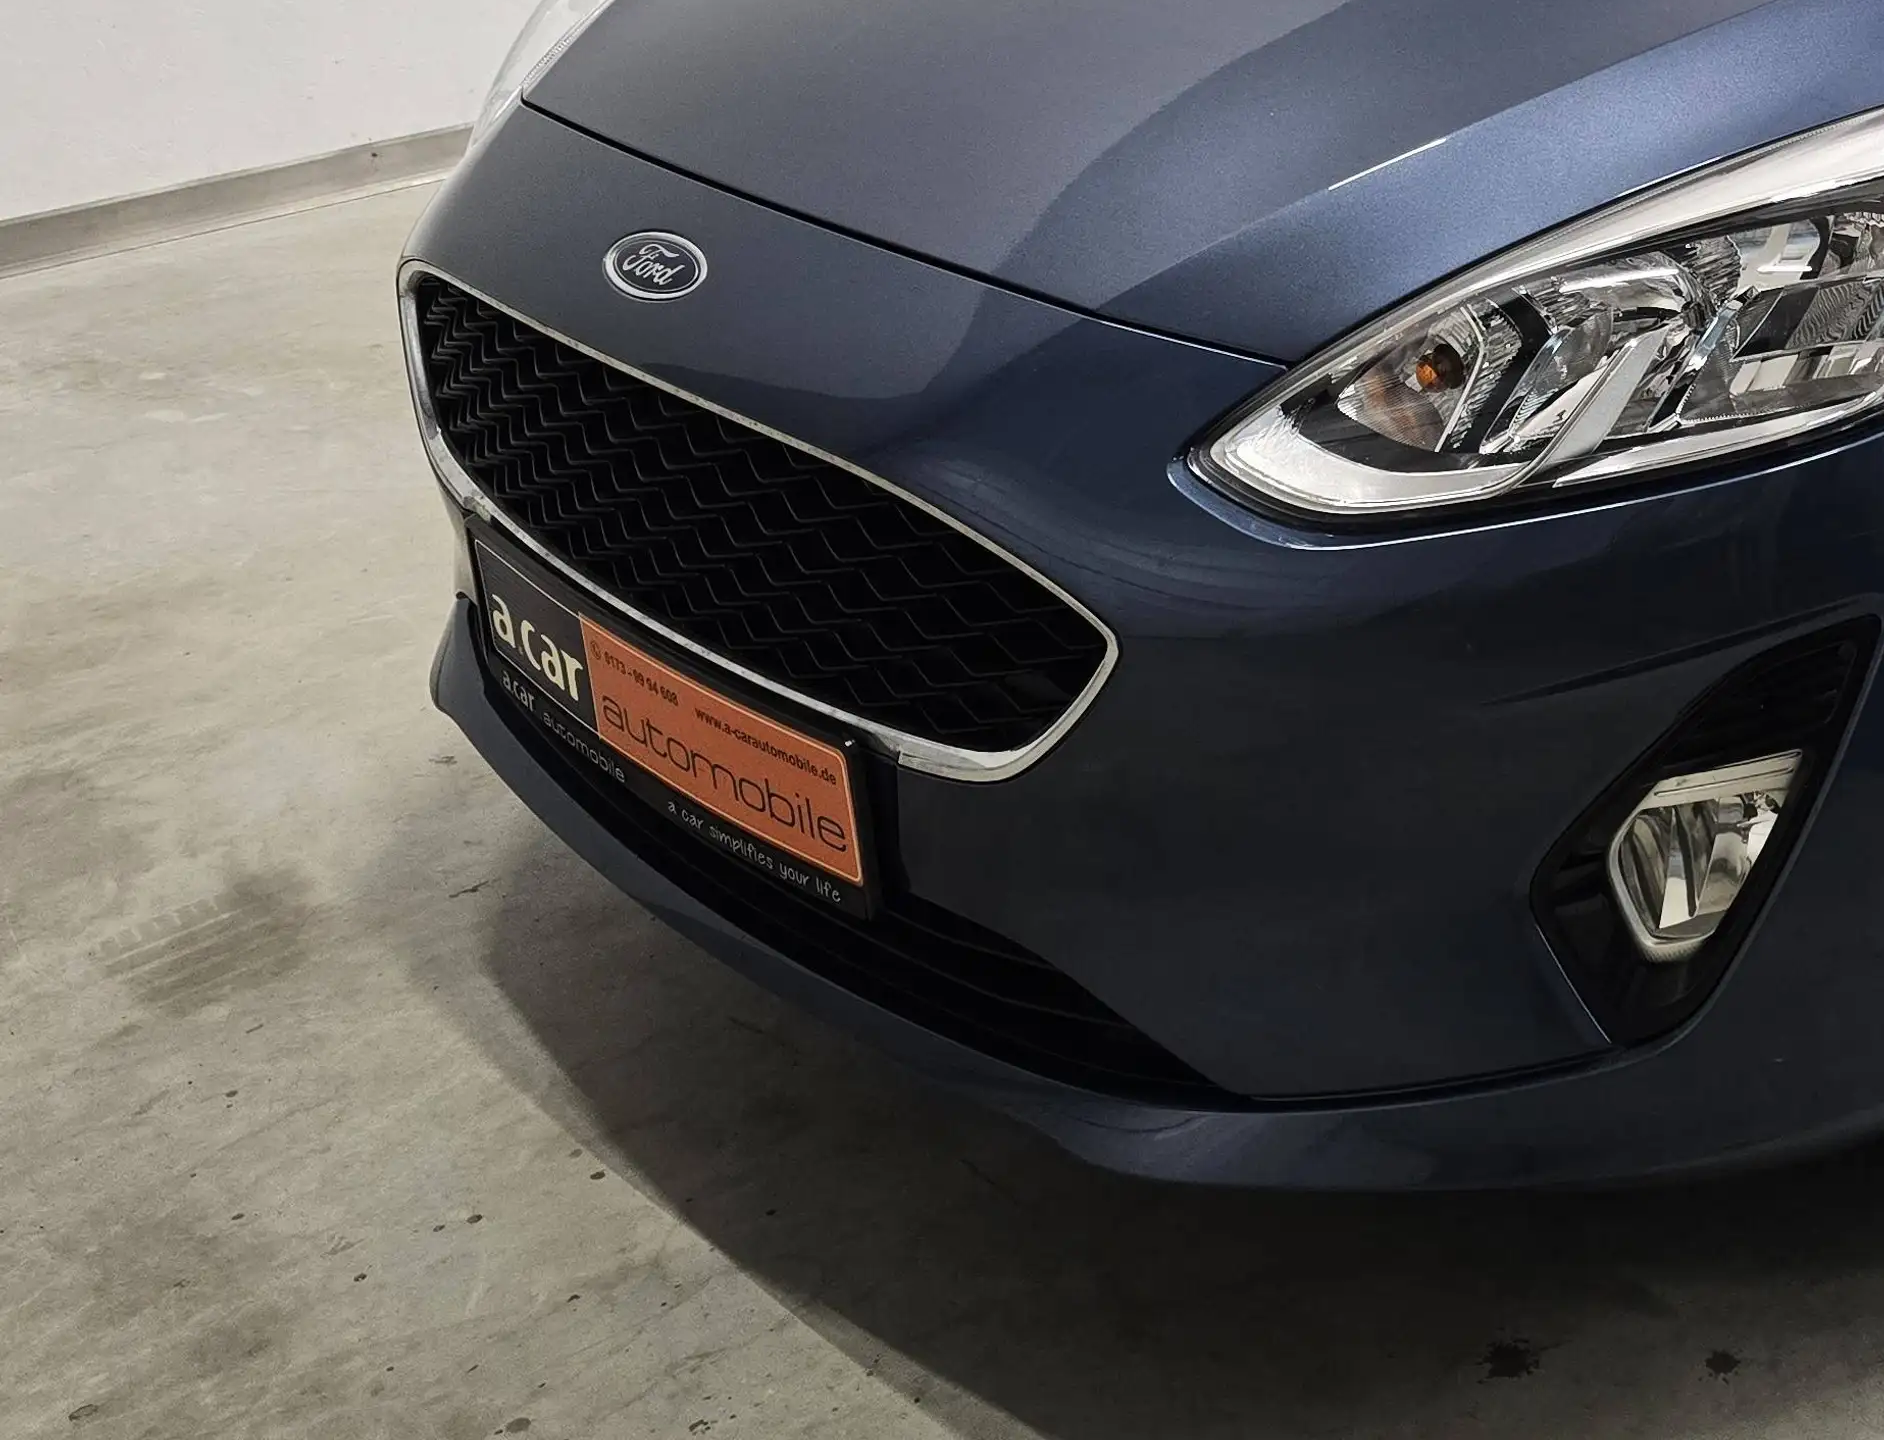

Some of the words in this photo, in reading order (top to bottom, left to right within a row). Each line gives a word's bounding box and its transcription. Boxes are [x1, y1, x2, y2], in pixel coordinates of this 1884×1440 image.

[621, 242, 686, 286] Ford
[491, 592, 584, 703] a.car
[601, 694, 848, 853] automobile
[542, 711, 626, 784] automobile
[694, 707, 837, 786] www.a-carautomobile.de
[682, 808, 705, 830] car
[708, 822, 774, 870] simplifies
[779, 861, 811, 887] your
[815, 872, 842, 904] life
